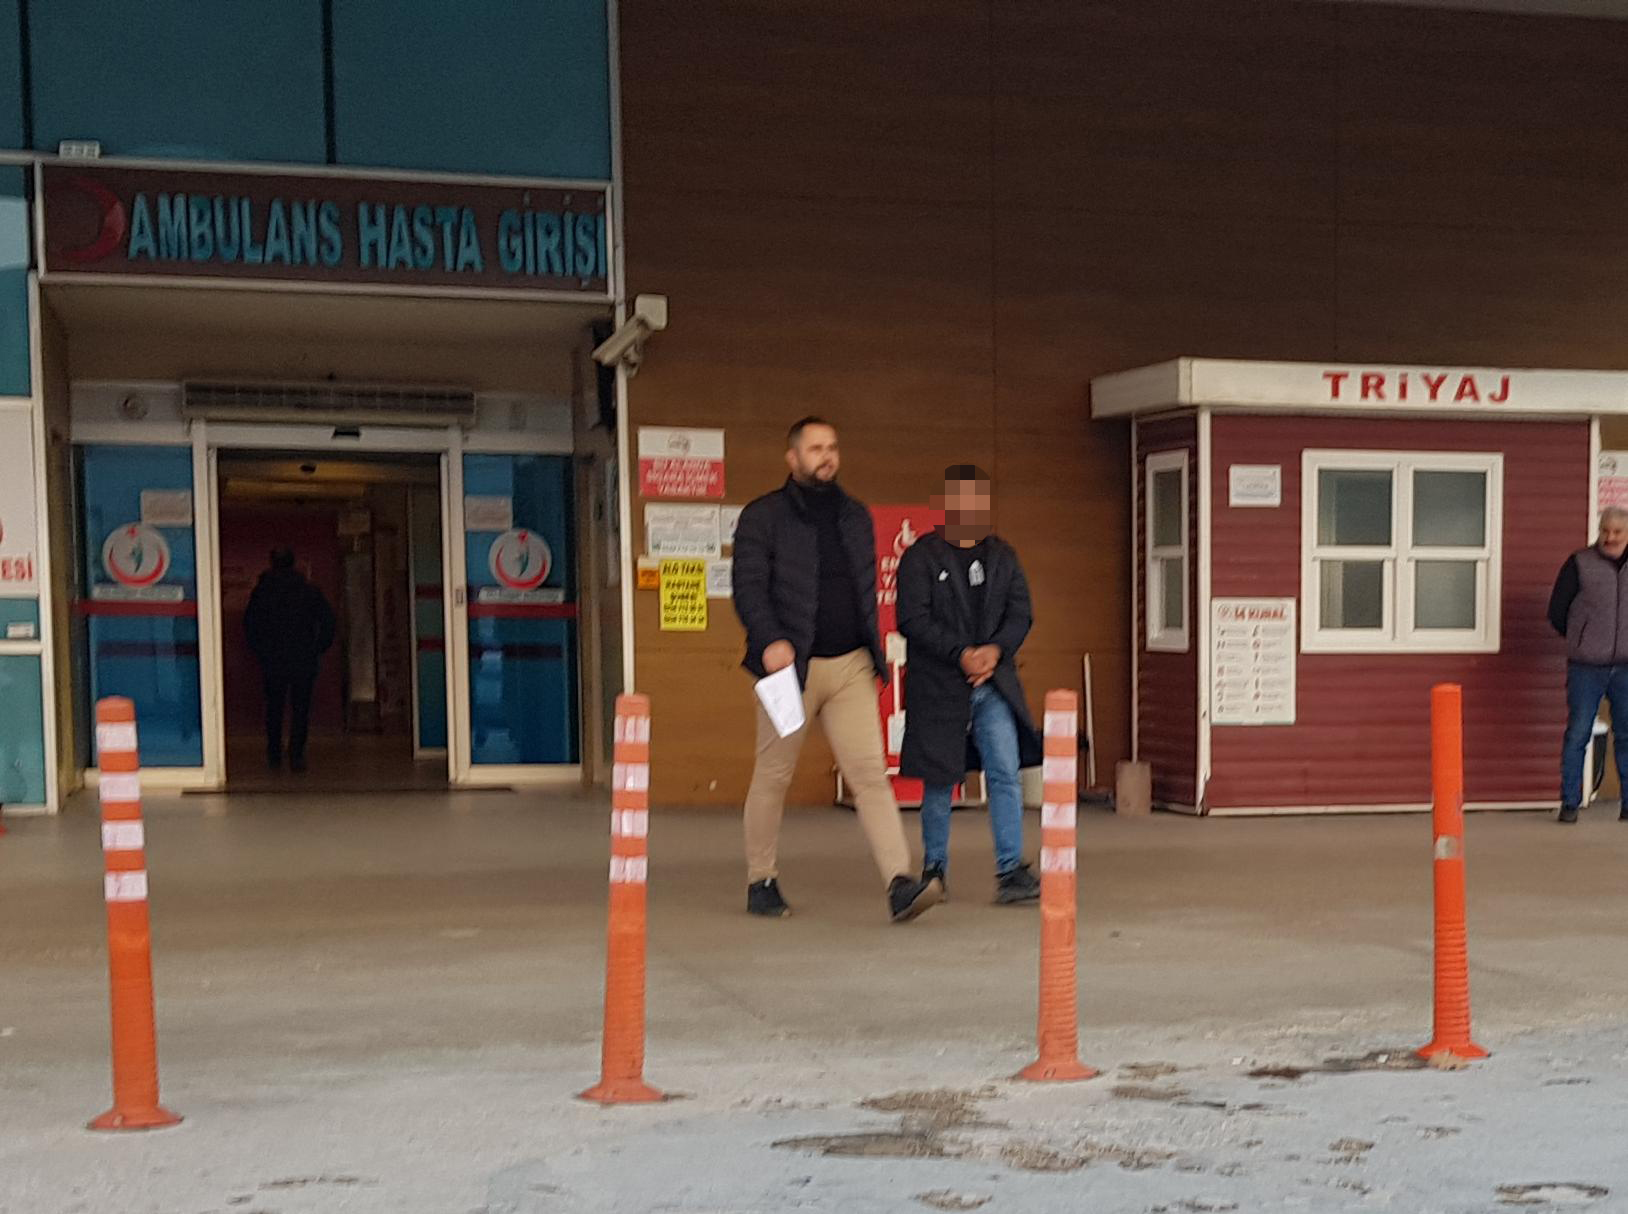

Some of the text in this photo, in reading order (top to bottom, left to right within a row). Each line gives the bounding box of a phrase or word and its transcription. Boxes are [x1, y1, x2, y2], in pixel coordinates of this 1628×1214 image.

[128, 191, 607, 288] AMBULANS HASTA GİRİŞİ
[1322, 371, 1512, 404] TRİYAJ
